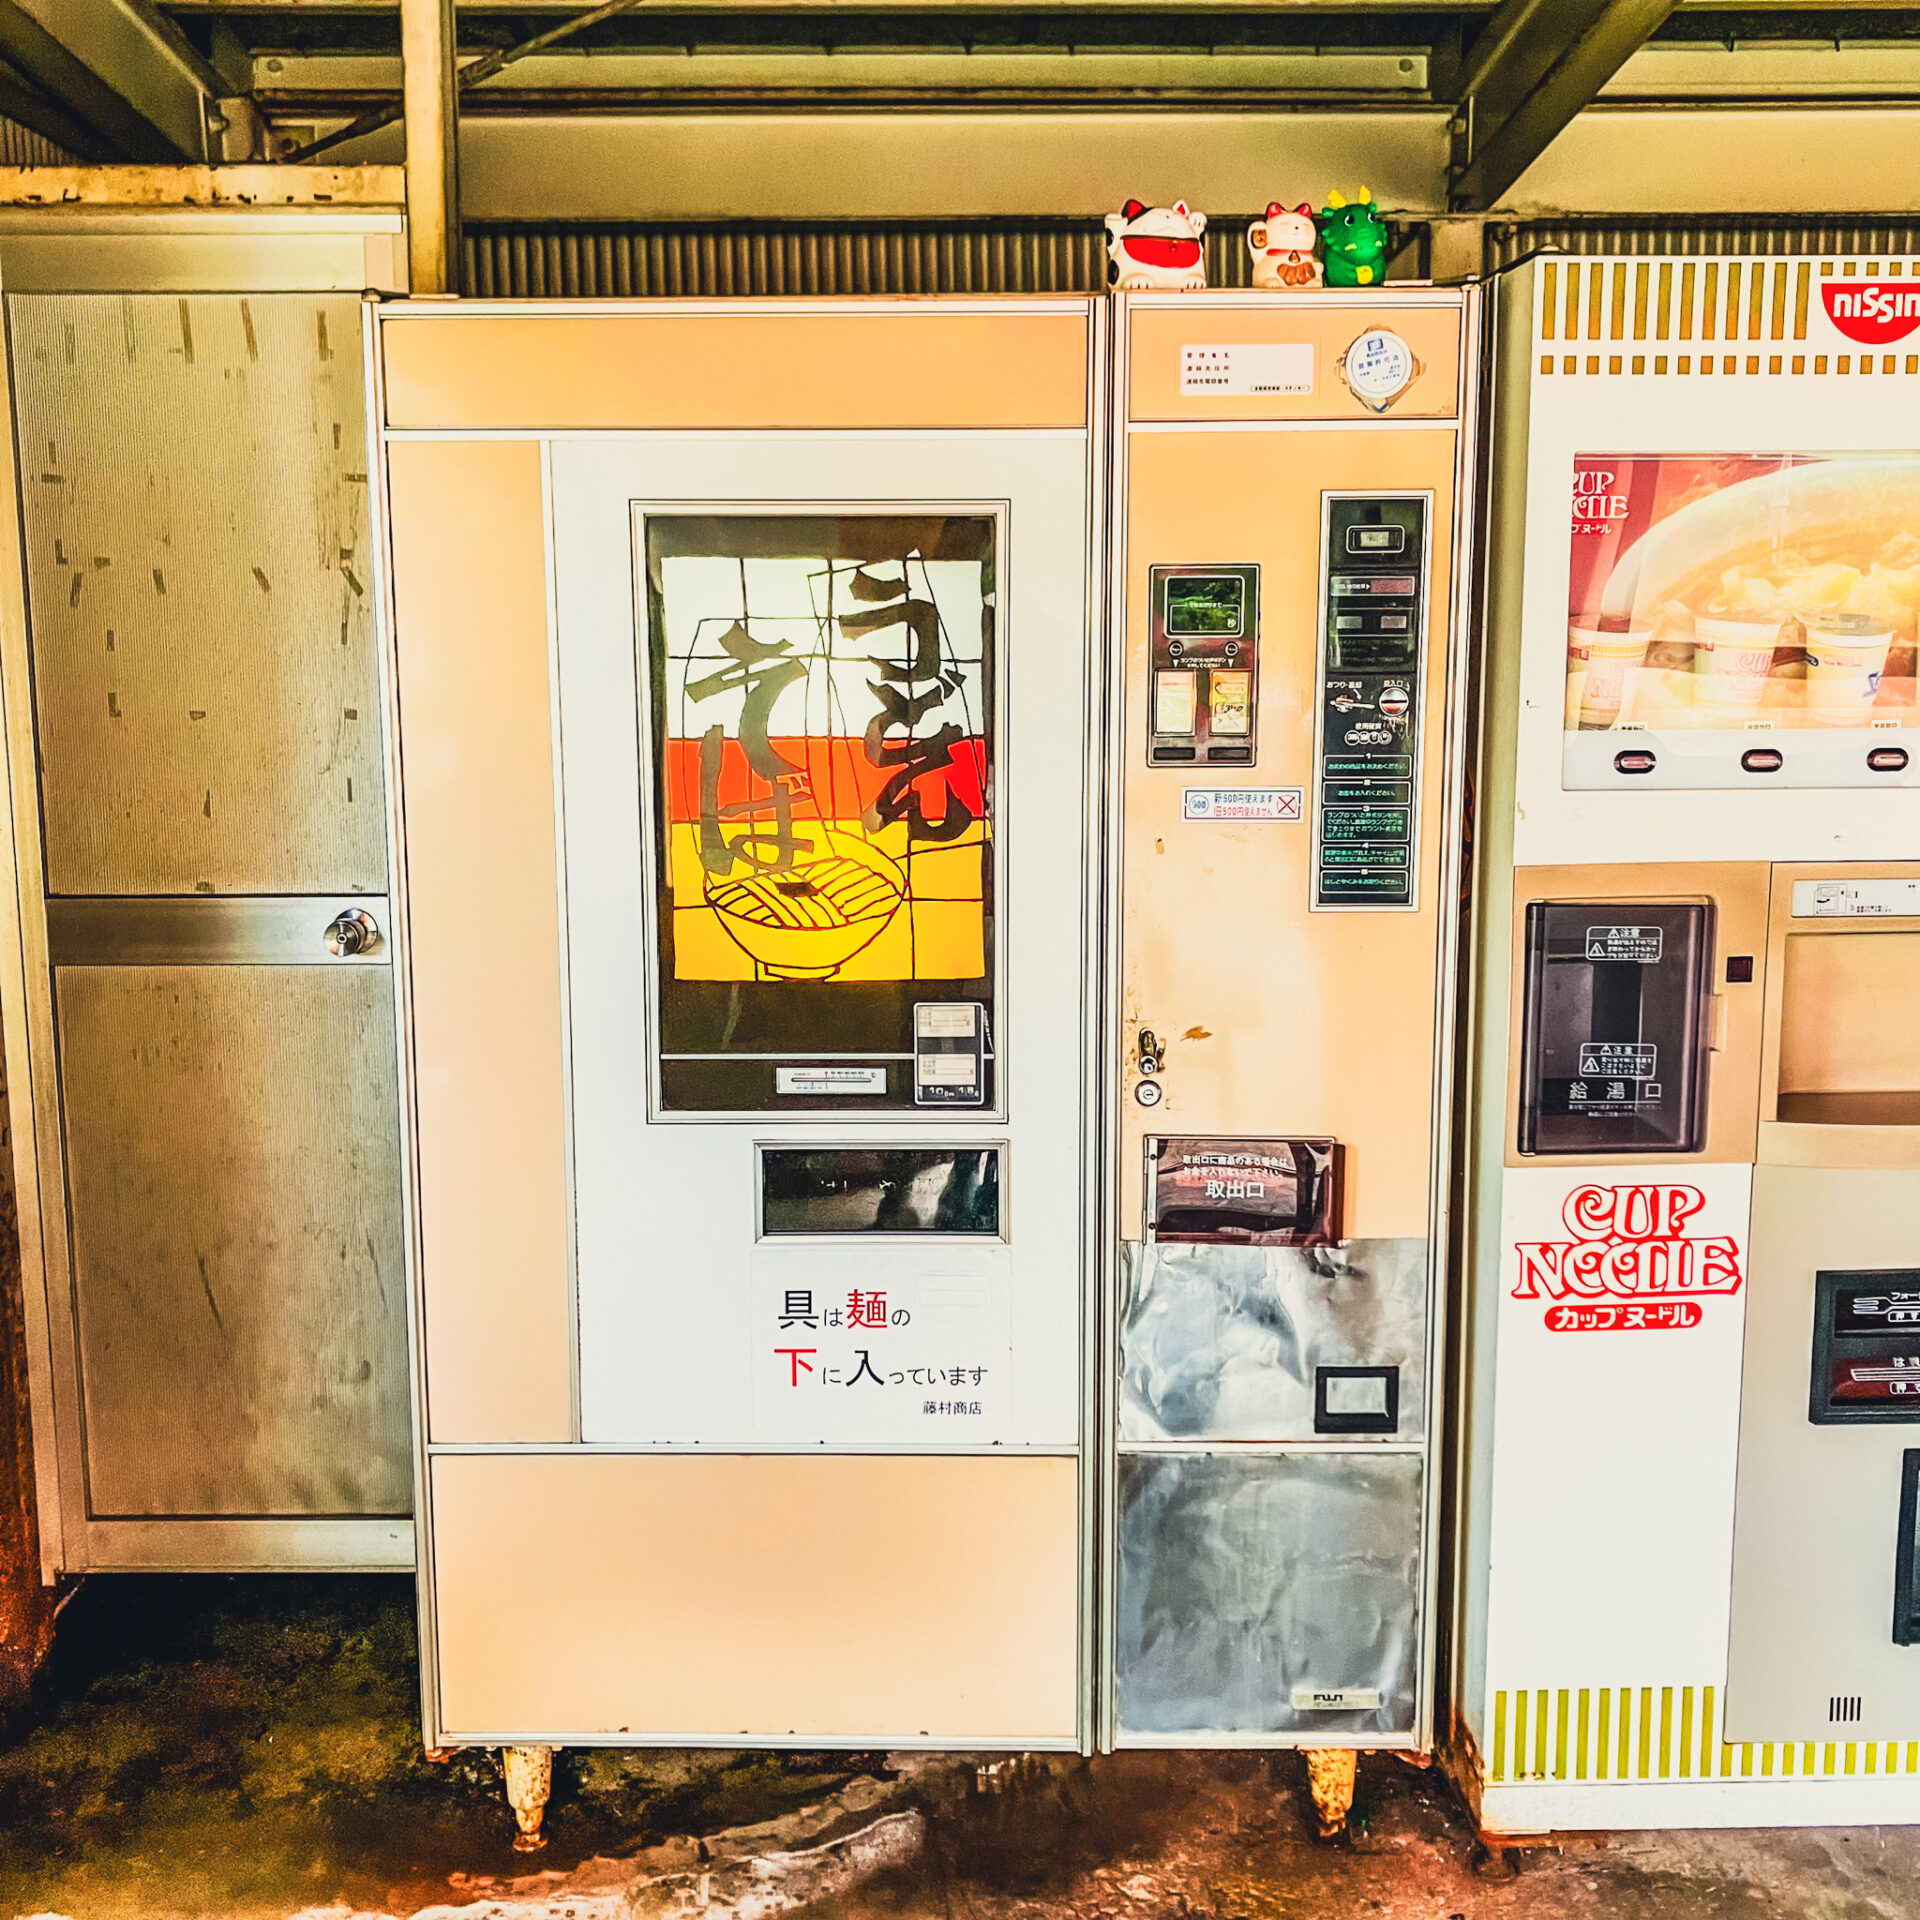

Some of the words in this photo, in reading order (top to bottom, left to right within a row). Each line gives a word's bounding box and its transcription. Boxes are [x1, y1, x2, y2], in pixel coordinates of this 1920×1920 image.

[1569, 1082, 1662, 1100] 給湯口
[1205, 1180, 1264, 1199] 取出口
[1562, 1185, 1706, 1241] CUP
[778, 1289, 911, 1329] 具は麺の
[1554, 1304, 1695, 1329] カップヌードル
[774, 1349, 988, 1387] 下に入っています
[922, 1401, 982, 1415] 藤村商店
